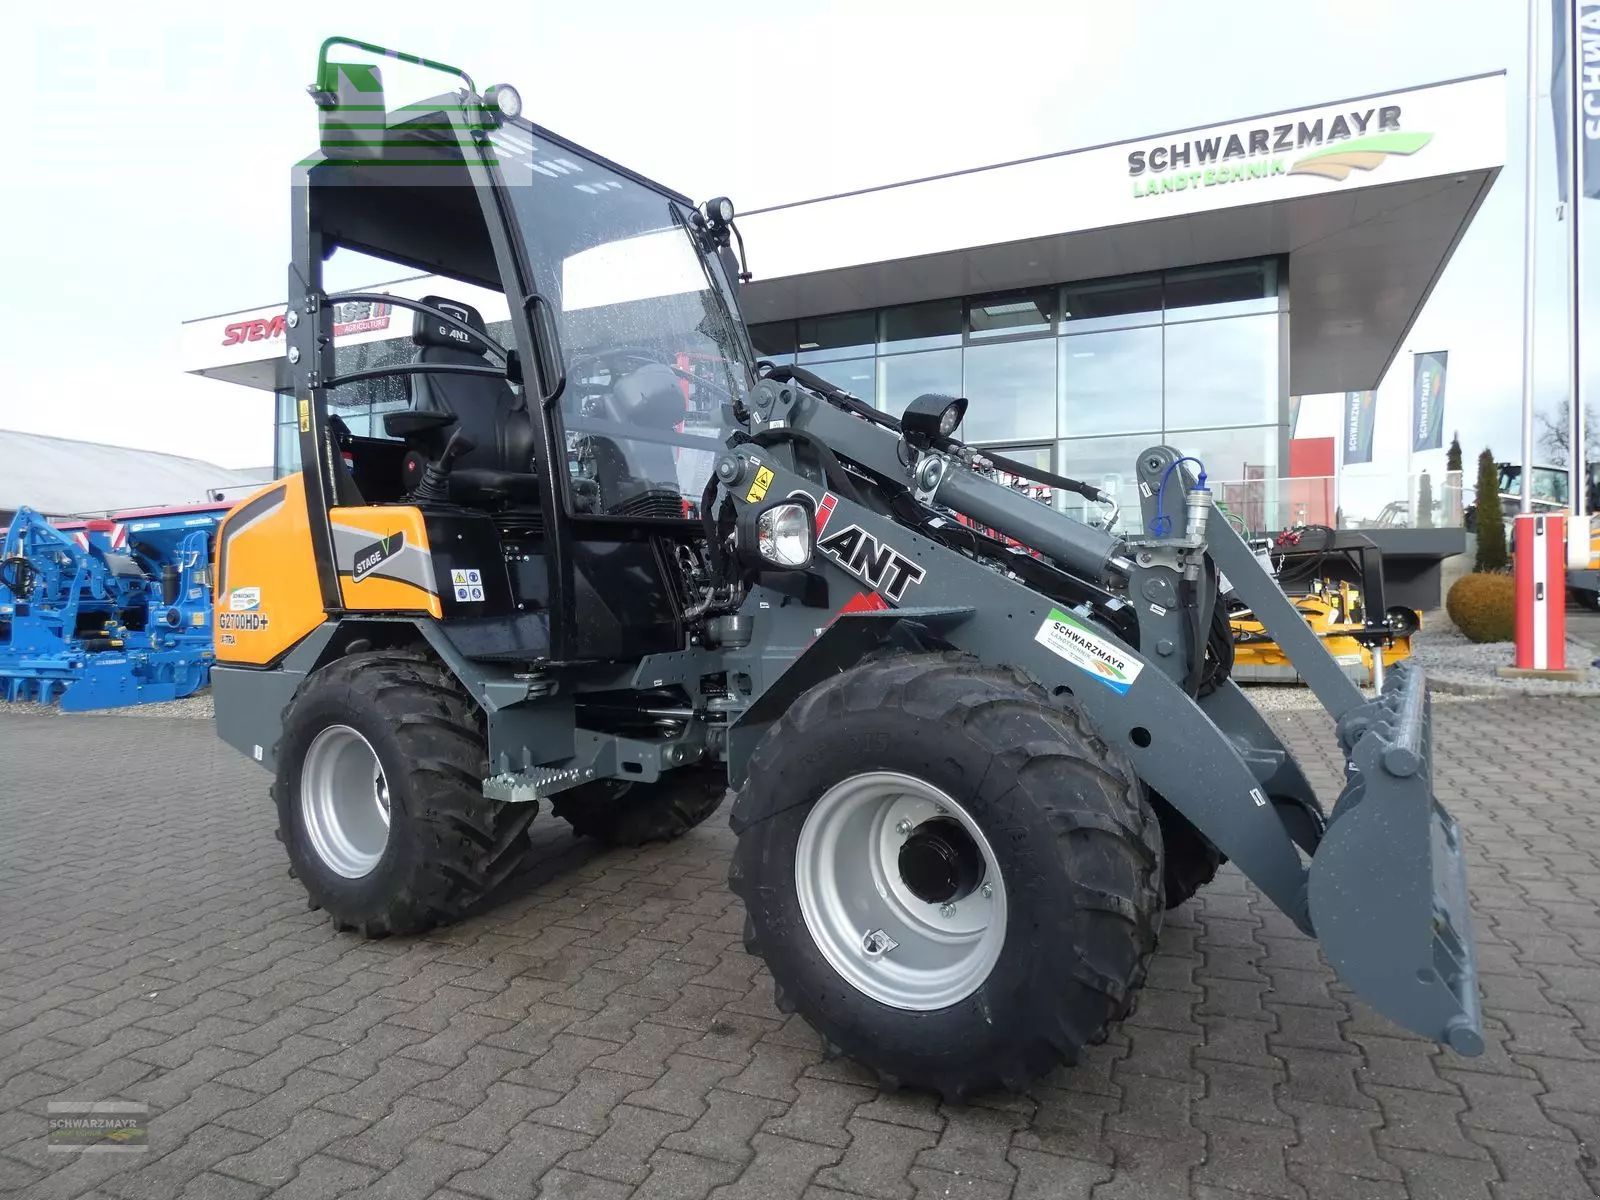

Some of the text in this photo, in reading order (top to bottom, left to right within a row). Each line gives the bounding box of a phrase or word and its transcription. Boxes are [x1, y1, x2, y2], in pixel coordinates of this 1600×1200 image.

[1128, 105, 1402, 176] SCHWARZMAYR
[1132, 157, 1286, 197] LANDTECHNIK
[344, 319, 387, 332] AGRICULTURE
[356, 551, 382, 573] STAGE
[220, 613, 268, 630] G2700HD+
[1050, 631, 1092, 660] LANDTECHNIK
[1053, 622, 1125, 671] SCHWARZMAYR
